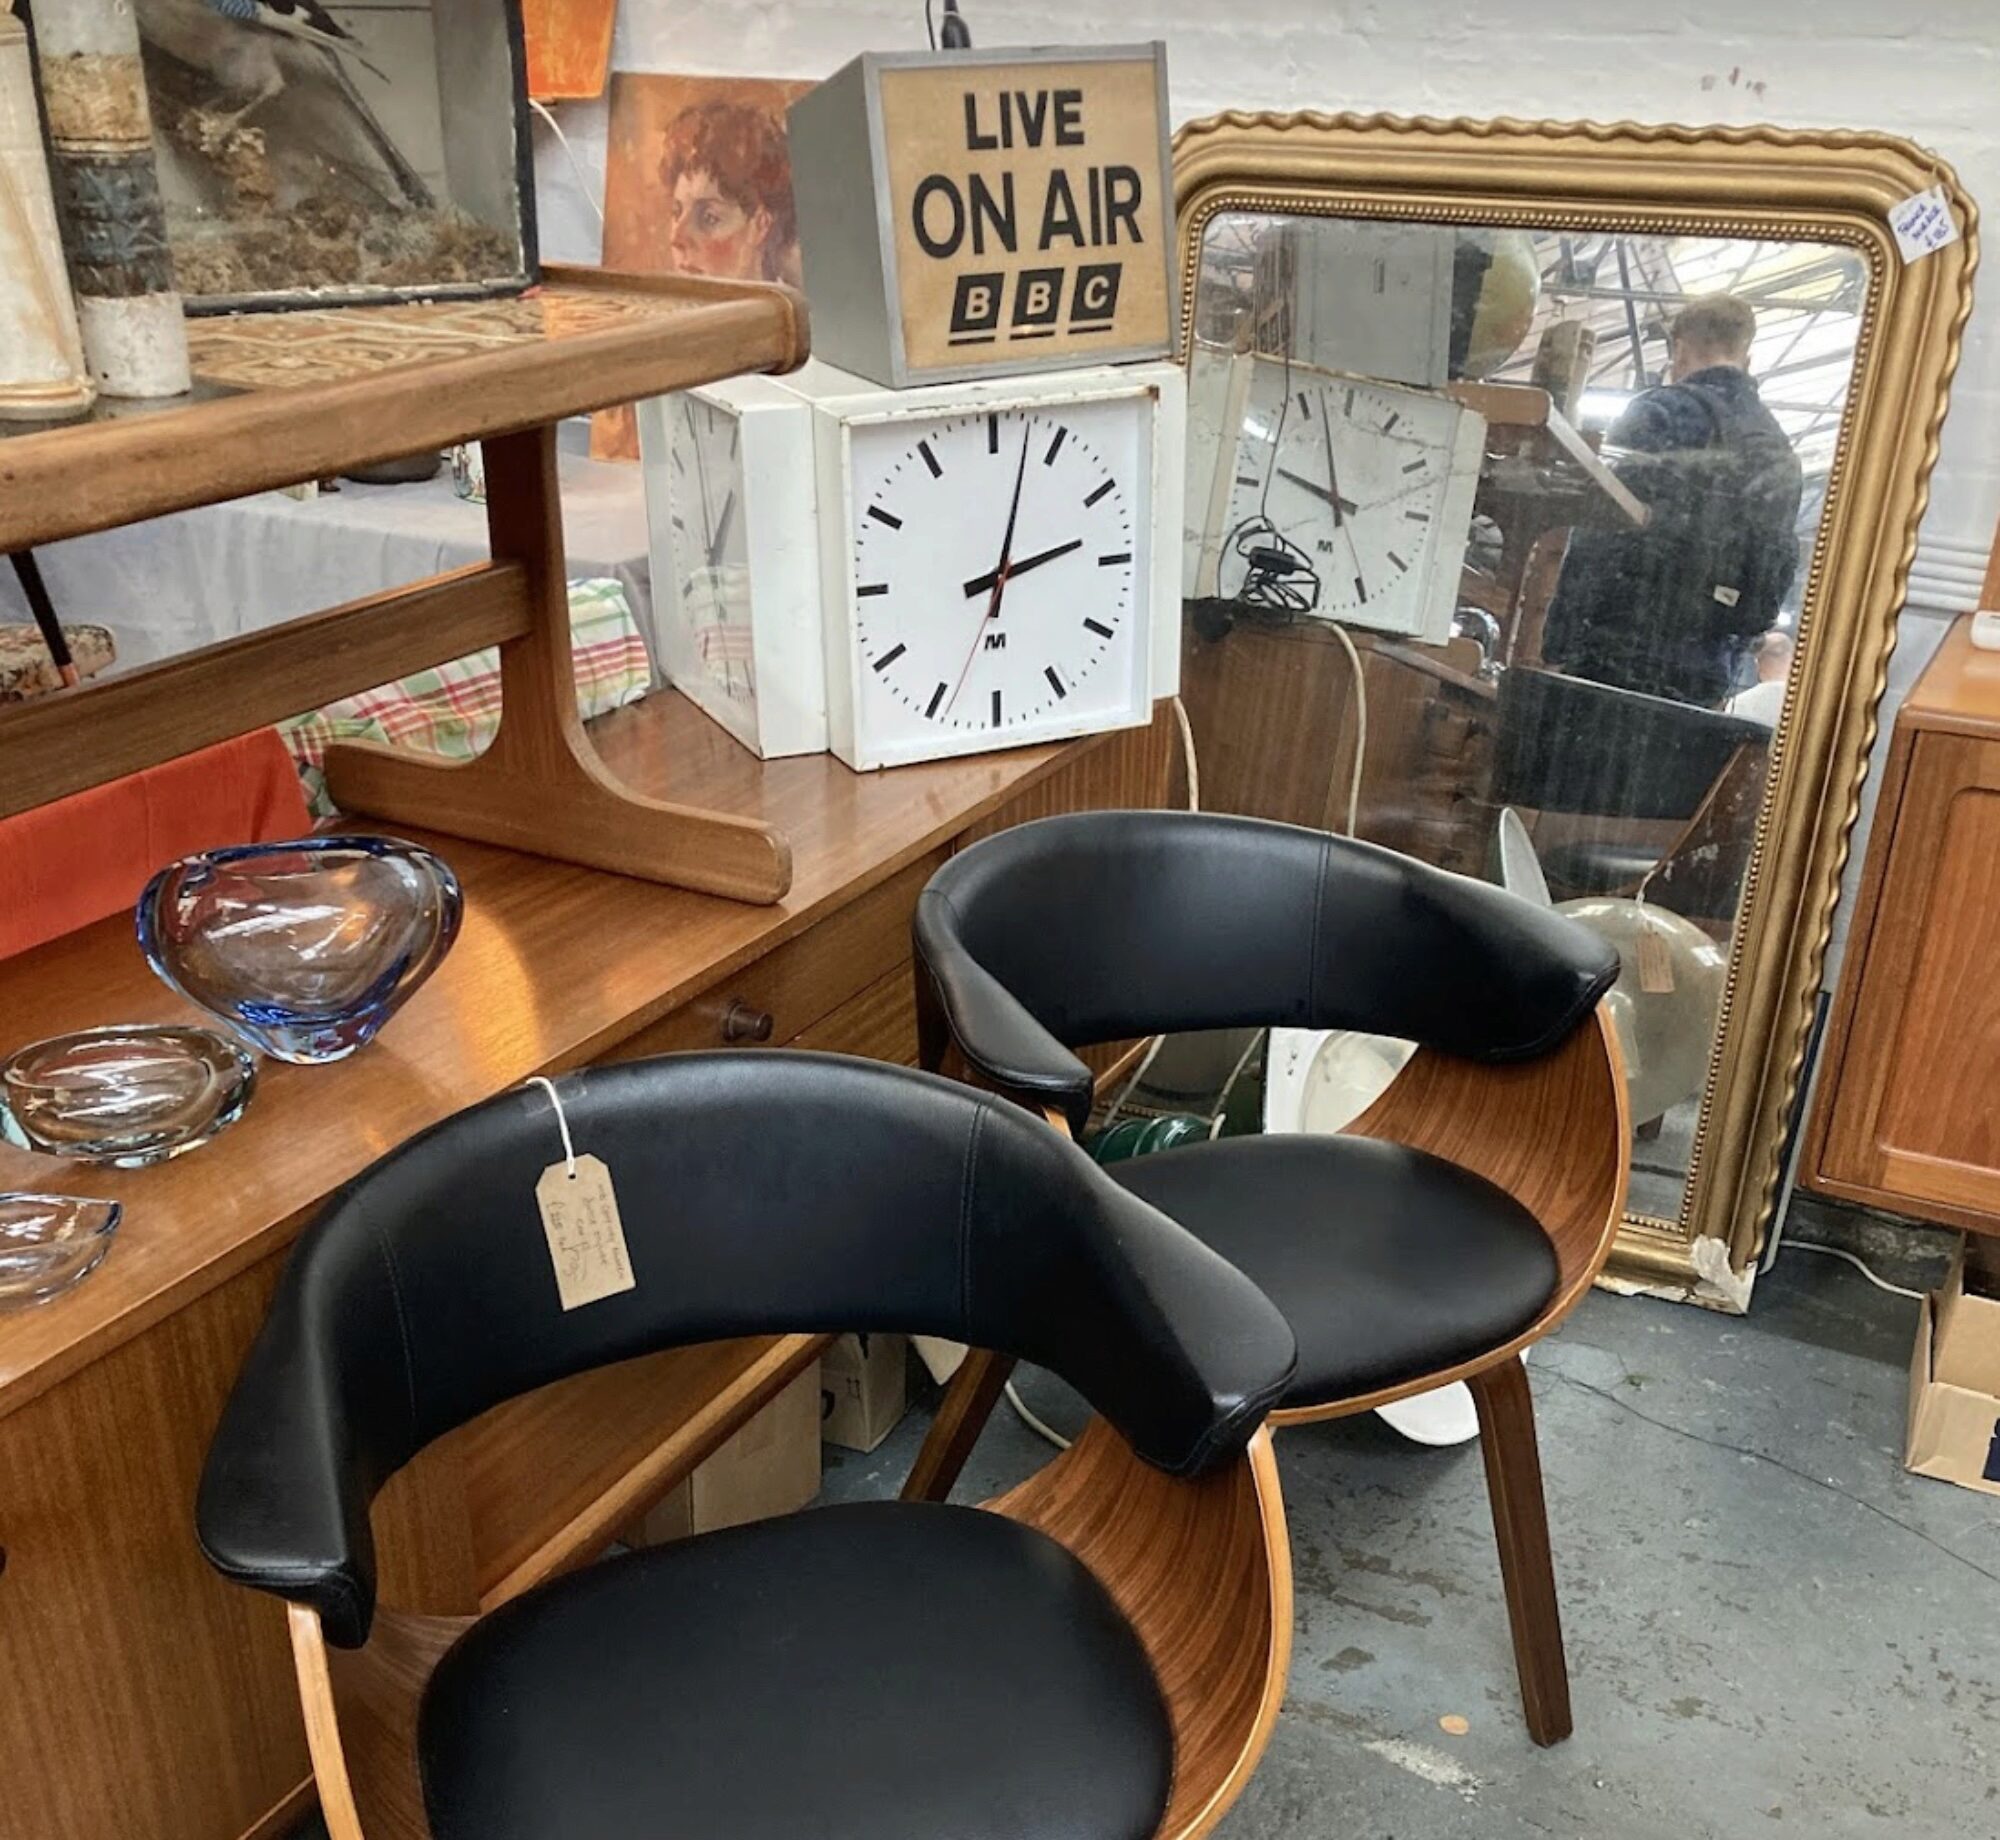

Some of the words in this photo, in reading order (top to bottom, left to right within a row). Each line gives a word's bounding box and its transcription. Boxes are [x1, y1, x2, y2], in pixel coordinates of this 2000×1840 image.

[964, 89, 1085, 150] LIVE
[912, 172, 1018, 259] ON
[1038, 165, 1143, 251] AIR
[955, 266, 1118, 329] BBC
